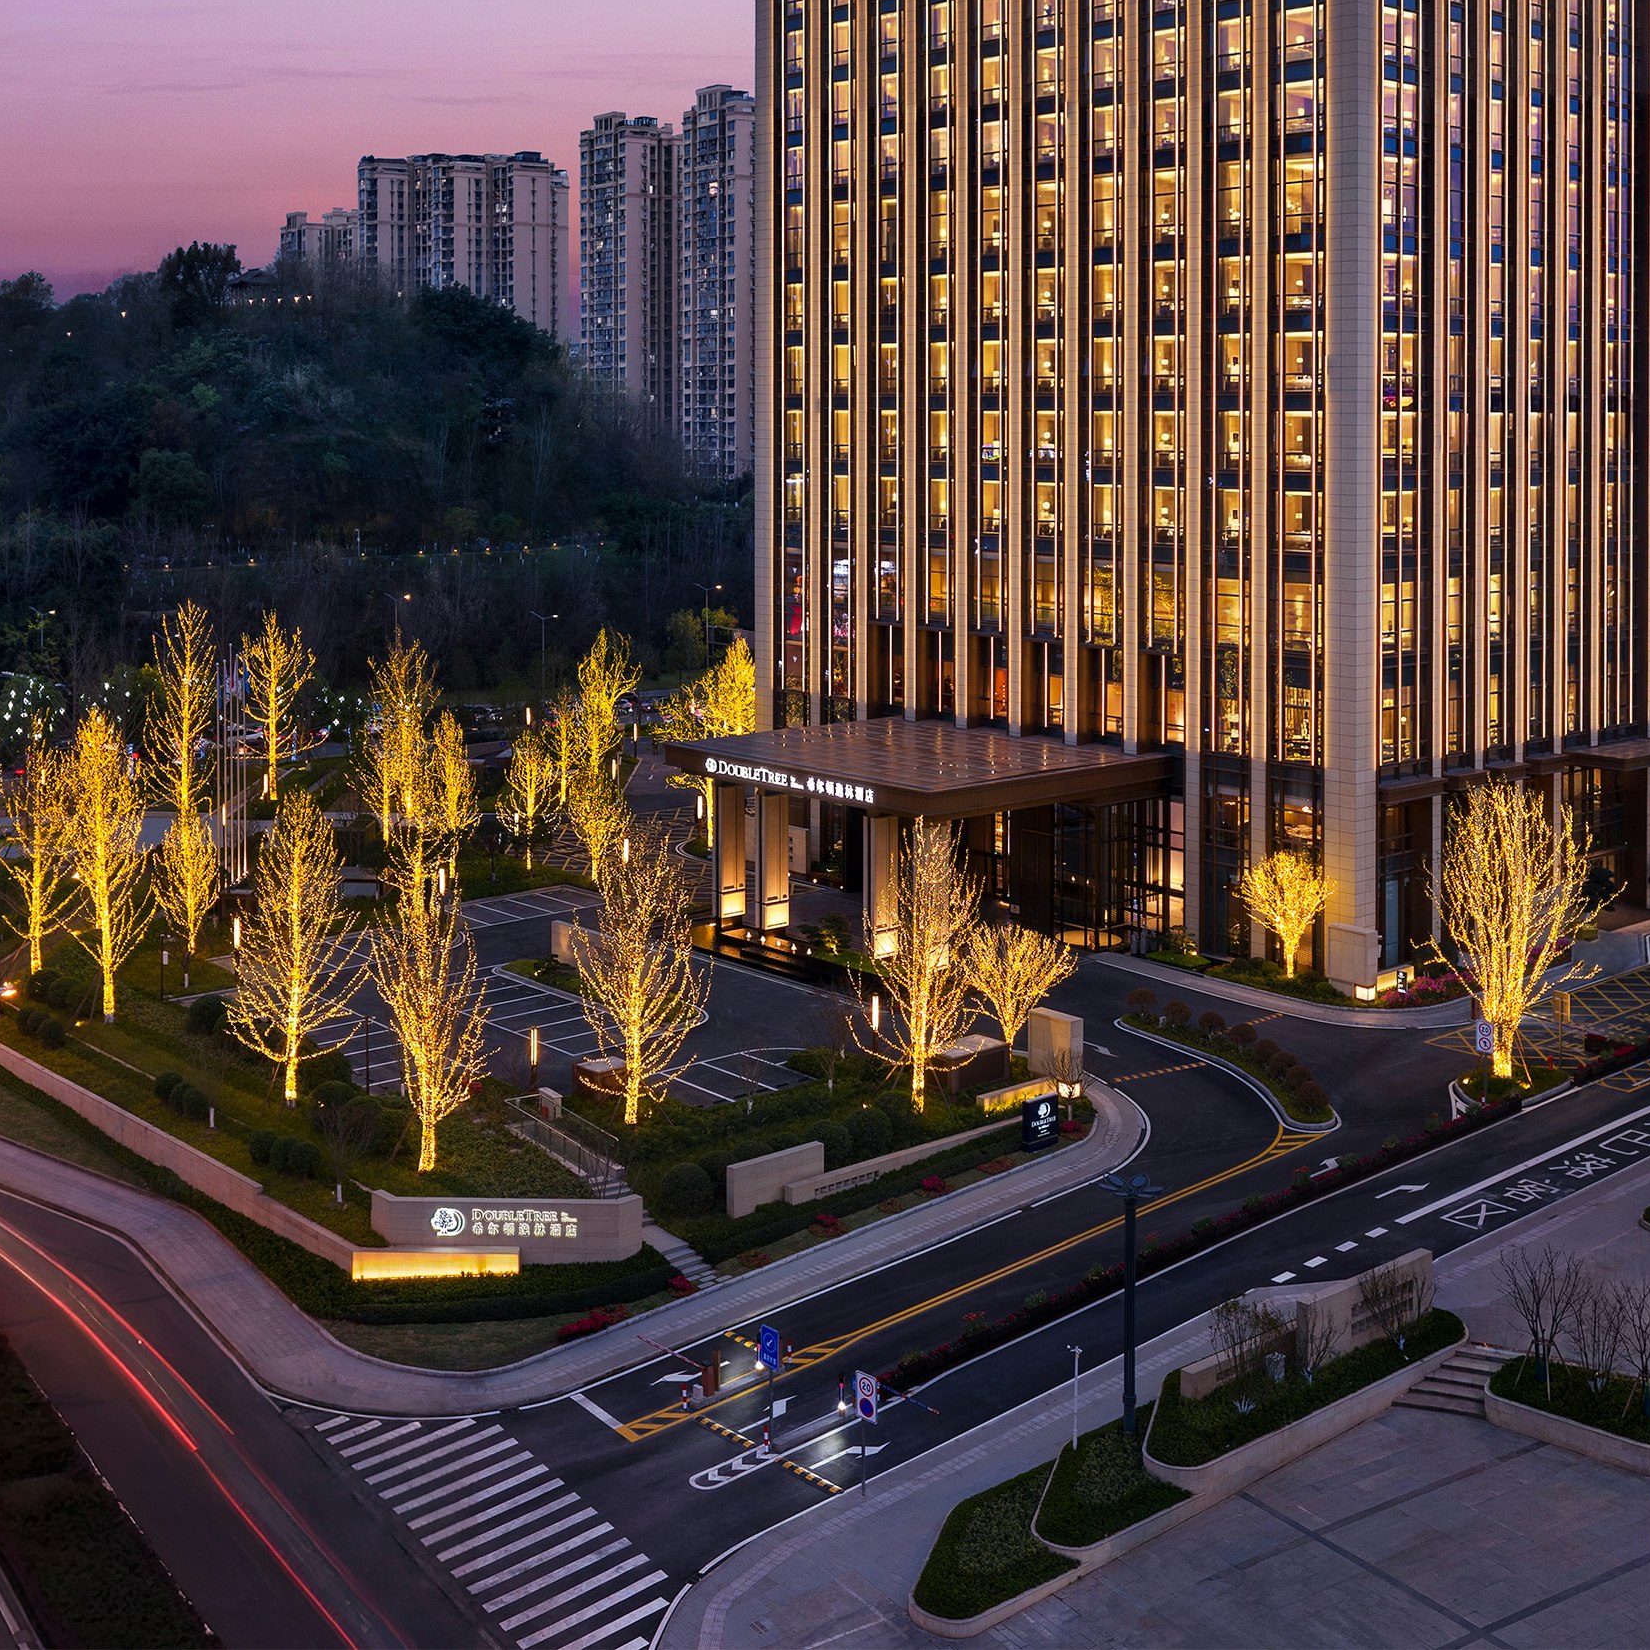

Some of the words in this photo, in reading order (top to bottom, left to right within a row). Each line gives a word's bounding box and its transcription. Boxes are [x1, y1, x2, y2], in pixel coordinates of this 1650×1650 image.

[472, 1222, 578, 1238] 希尔顿逸林酒店
[862, 1381, 870, 1392] 20
